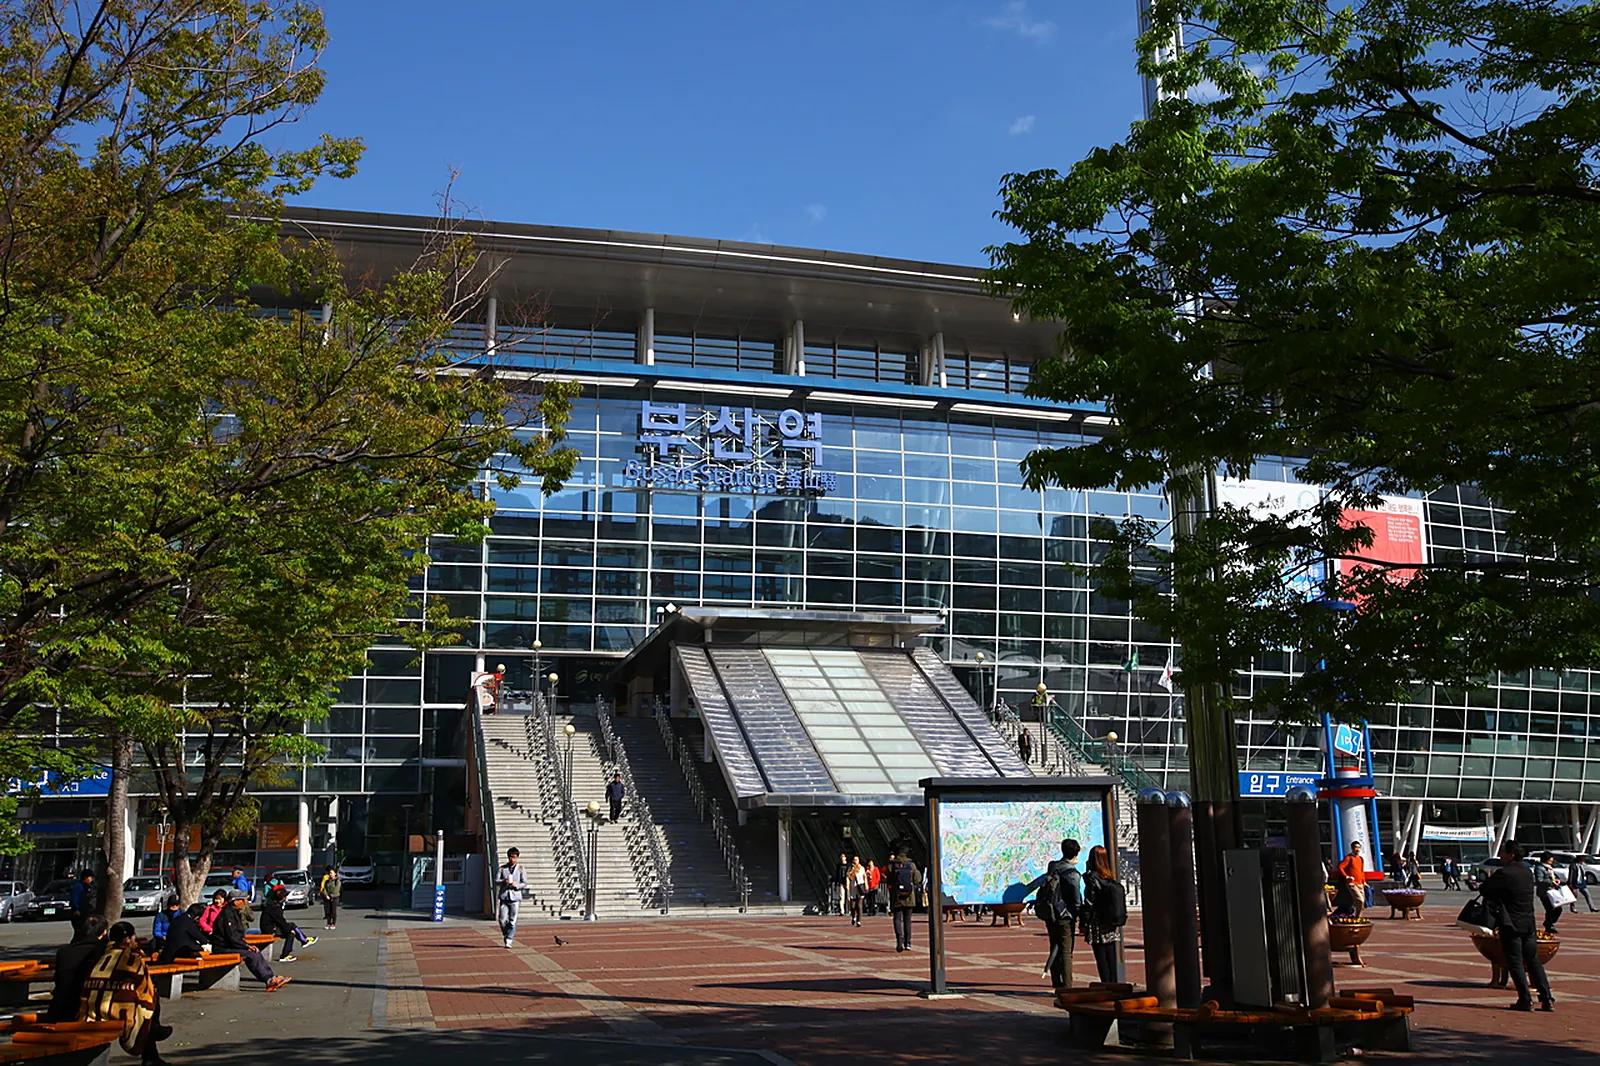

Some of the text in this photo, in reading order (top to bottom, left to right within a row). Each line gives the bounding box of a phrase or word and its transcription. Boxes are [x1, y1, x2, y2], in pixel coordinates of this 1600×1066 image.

[640, 400, 824, 467] 부산역
[625, 459, 695, 483] Busan
[699, 464, 778, 489] Station
[1250, 774, 1280, 793] 입구
[1285, 775, 1315, 784] Entrance
